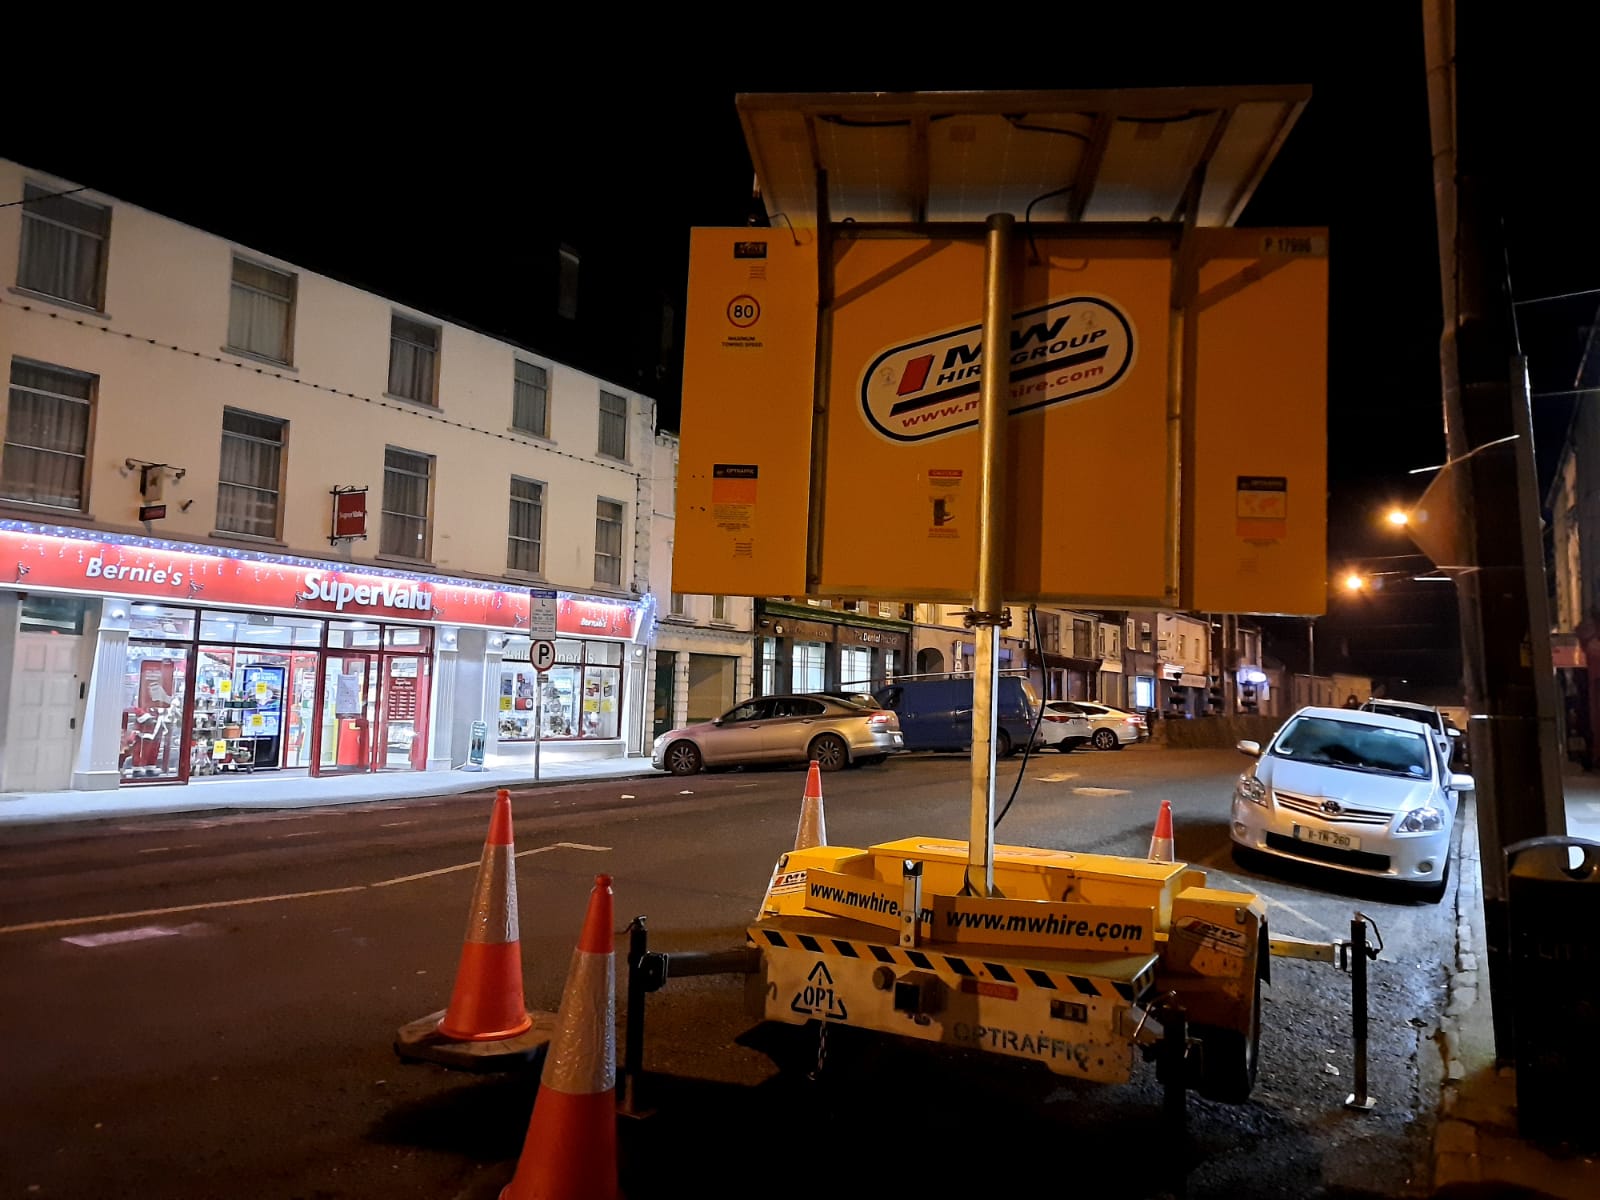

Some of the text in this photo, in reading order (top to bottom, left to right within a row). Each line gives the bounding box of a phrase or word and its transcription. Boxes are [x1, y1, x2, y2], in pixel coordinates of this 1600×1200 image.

[734, 305, 754, 318] 80
[1010, 329, 1106, 365] GROUP
[902, 366, 1104, 428] www.mire.com
[86, 556, 183, 586] Bernie's
[302, 573, 432, 611] SuperValu
[538, 643, 549, 665] P
[810, 882, 935, 925] www.mwhire.m
[946, 910, 1142, 941] www.mwhire.com
[953, 1022, 1089, 1064] OPTRAFFIC
